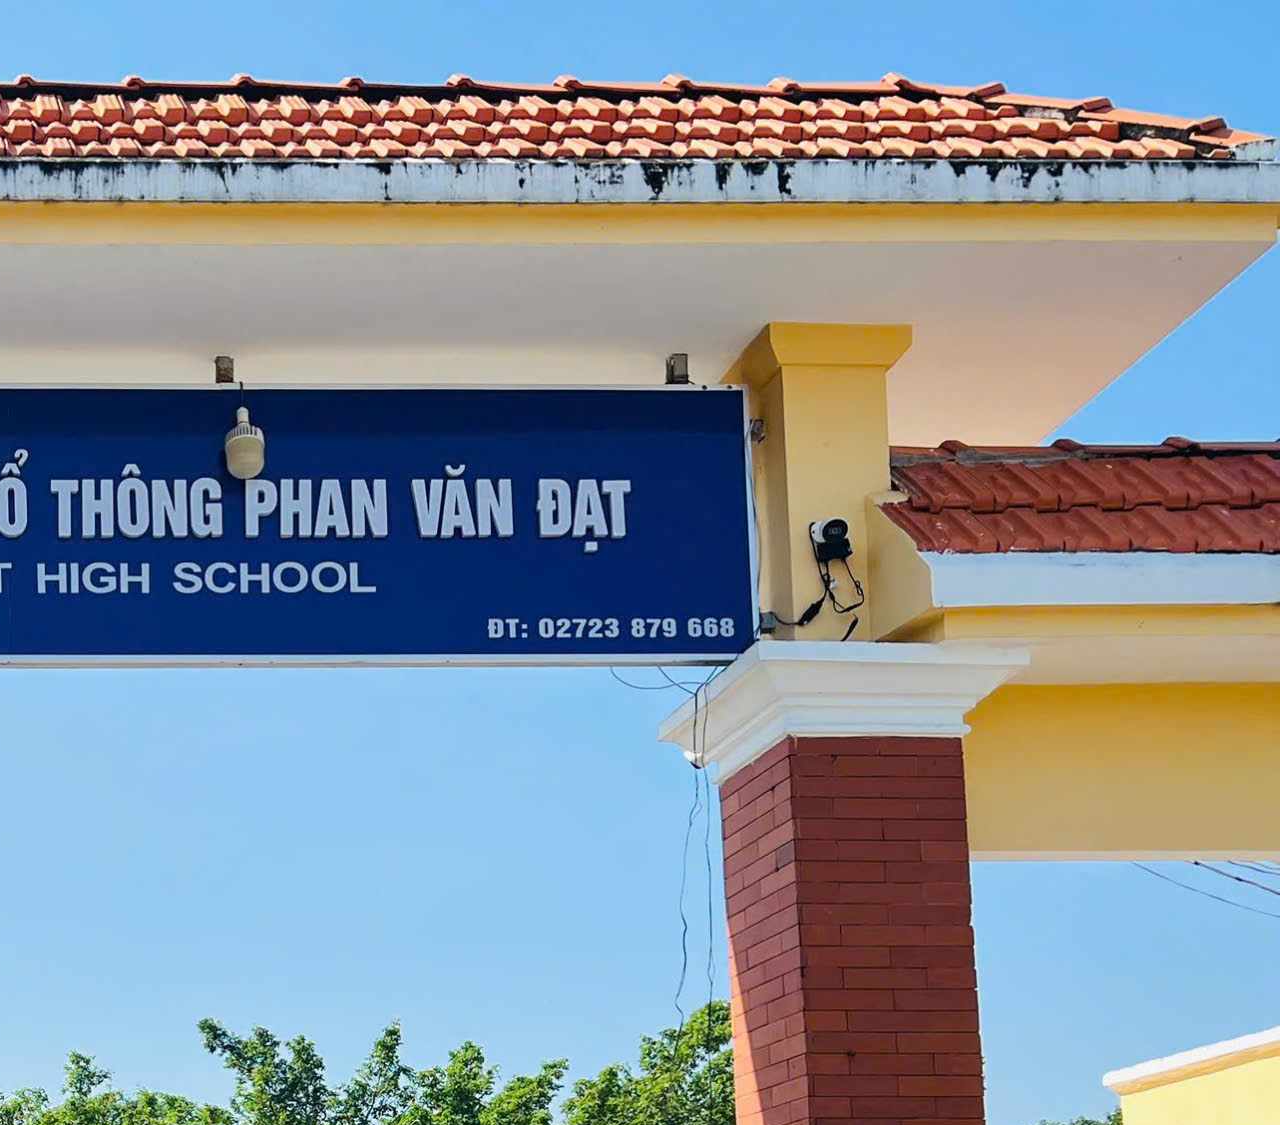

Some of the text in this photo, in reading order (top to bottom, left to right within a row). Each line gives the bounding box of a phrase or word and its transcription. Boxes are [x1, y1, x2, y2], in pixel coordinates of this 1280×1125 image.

[50, 463, 223, 539] THÔNG
[244, 478, 389, 539] PHAN
[411, 464, 514, 539] VĂN
[536, 478, 632, 552] ĐẠT
[36, 561, 150, 594] HIGH
[172, 561, 377, 594] SCHOOL
[487, 617, 735, 639] ĐT: 02723 879 668
